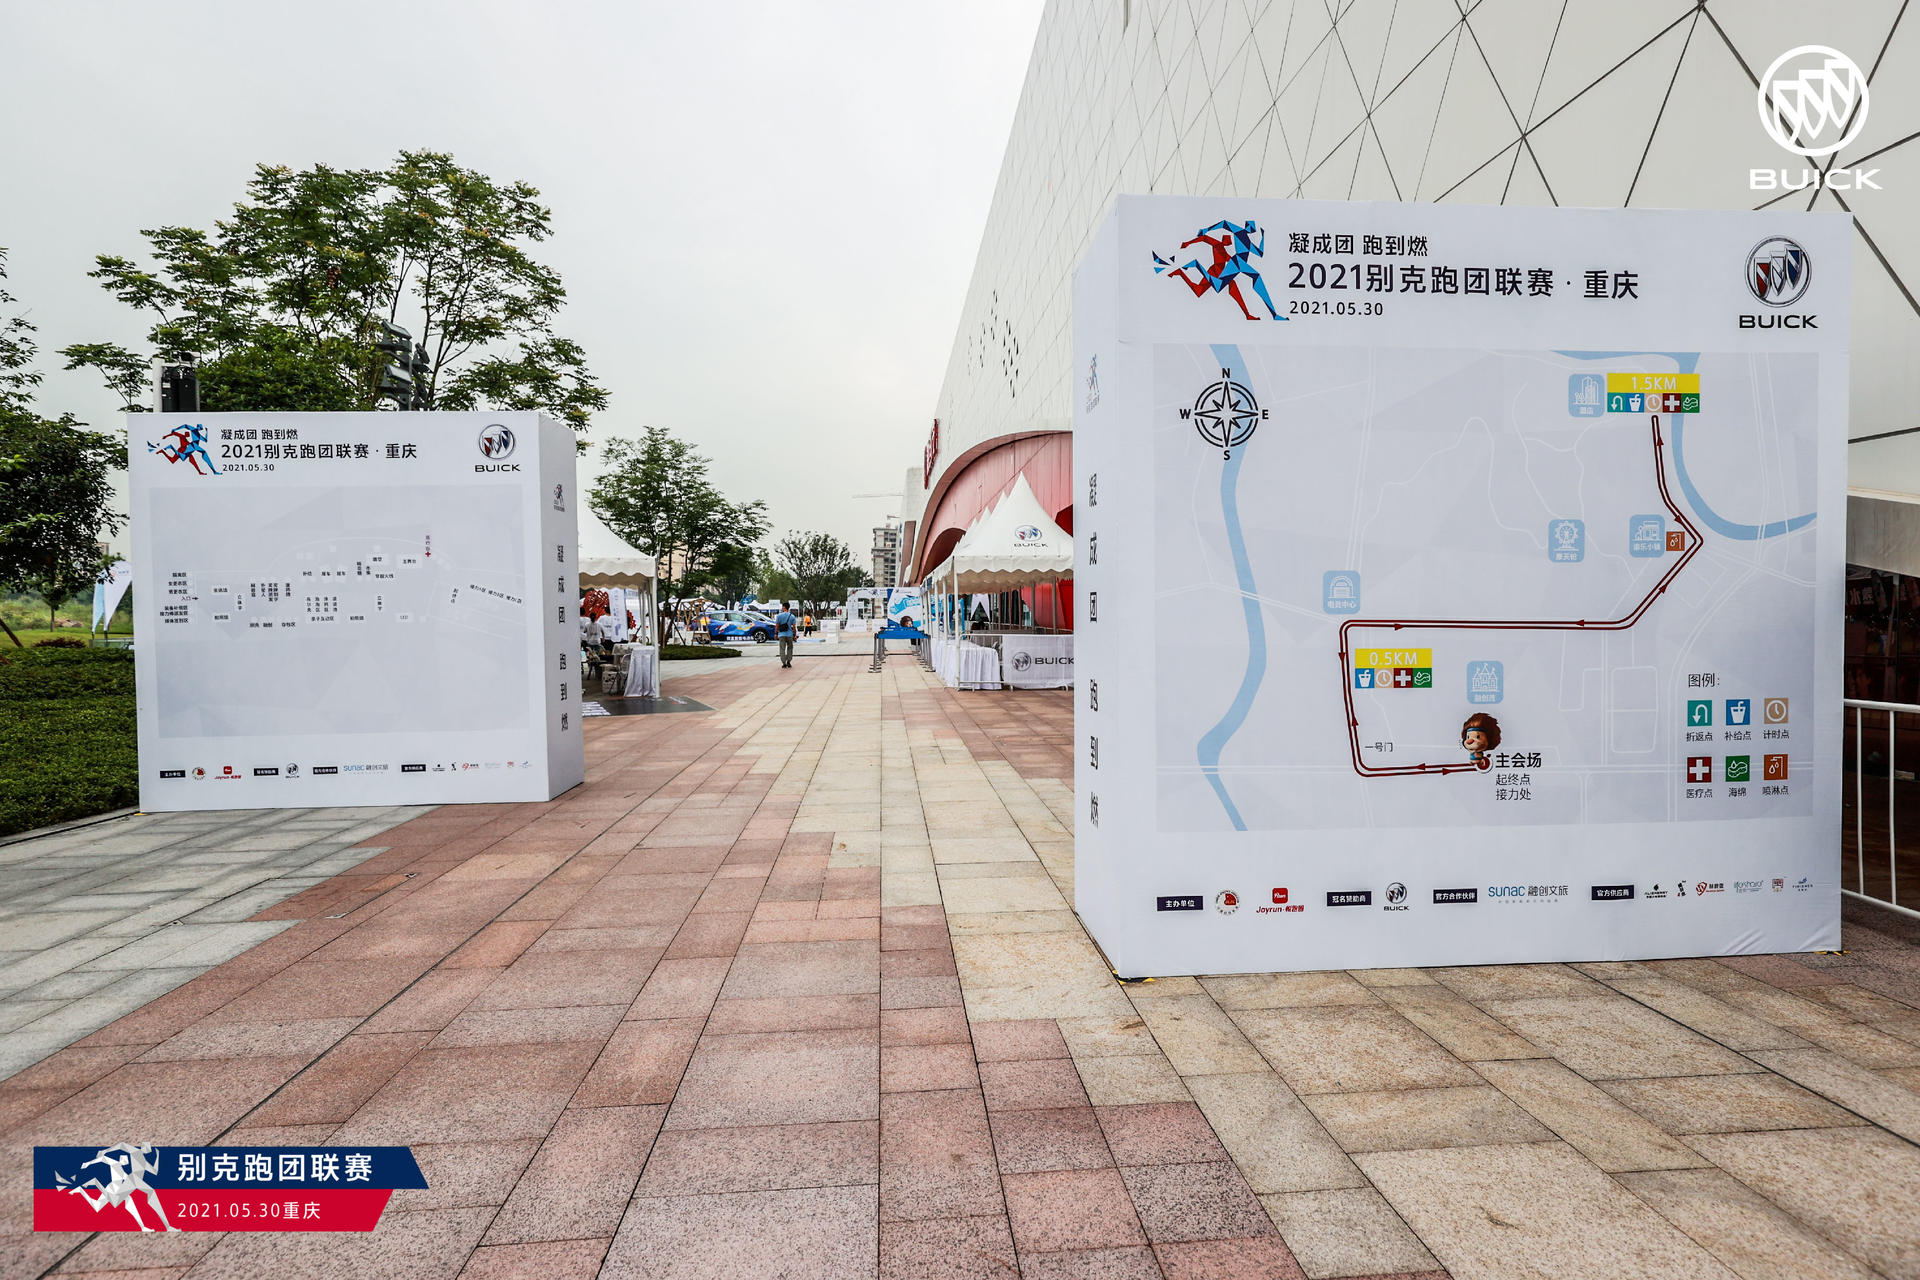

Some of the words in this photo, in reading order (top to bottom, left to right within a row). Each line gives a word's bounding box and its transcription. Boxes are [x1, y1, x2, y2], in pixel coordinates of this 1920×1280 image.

[1288, 232, 1354, 255] 凝成团
[1363, 234, 1428, 257] 跑到燃
[1289, 301, 1384, 316] 2021.05.30
[1738, 314, 1819, 329] BUICK
[1222, 368, 1230, 378] N
[1631, 376, 1677, 391] 1.5KM
[1179, 408, 1191, 419] W
[1262, 409, 1269, 420] E
[220, 428, 258, 441] 凝成团
[261, 428, 299, 441] 跑到燃
[1223, 450, 1231, 461] S
[222, 463, 275, 472] 2021.05.30
[474, 464, 521, 473] BUICK
[1034, 656, 1074, 665] BUICK
[1369, 651, 1418, 666] 0.5KM
[1686, 732, 1713, 742] 折返点
[1725, 731, 1752, 741] 补给点
[1763, 729, 1790, 739] 计时点
[1364, 742, 1393, 752] 一号门
[1495, 752, 1542, 769] 主会场
[1496, 773, 1531, 786] 起终点
[1496, 788, 1532, 801] 接力处
[1686, 788, 1713, 798] 医疗点
[1728, 787, 1747, 797] 海绵
[1762, 785, 1789, 795] 喷淋点
[1488, 885, 1525, 897] sunac
[1527, 885, 1568, 897] 融创文旅
[1596, 889, 1630, 898] 官方供应商
[1435, 892, 1476, 901] 官方合作伙伴
[1165, 900, 1195, 908] 主办单位
